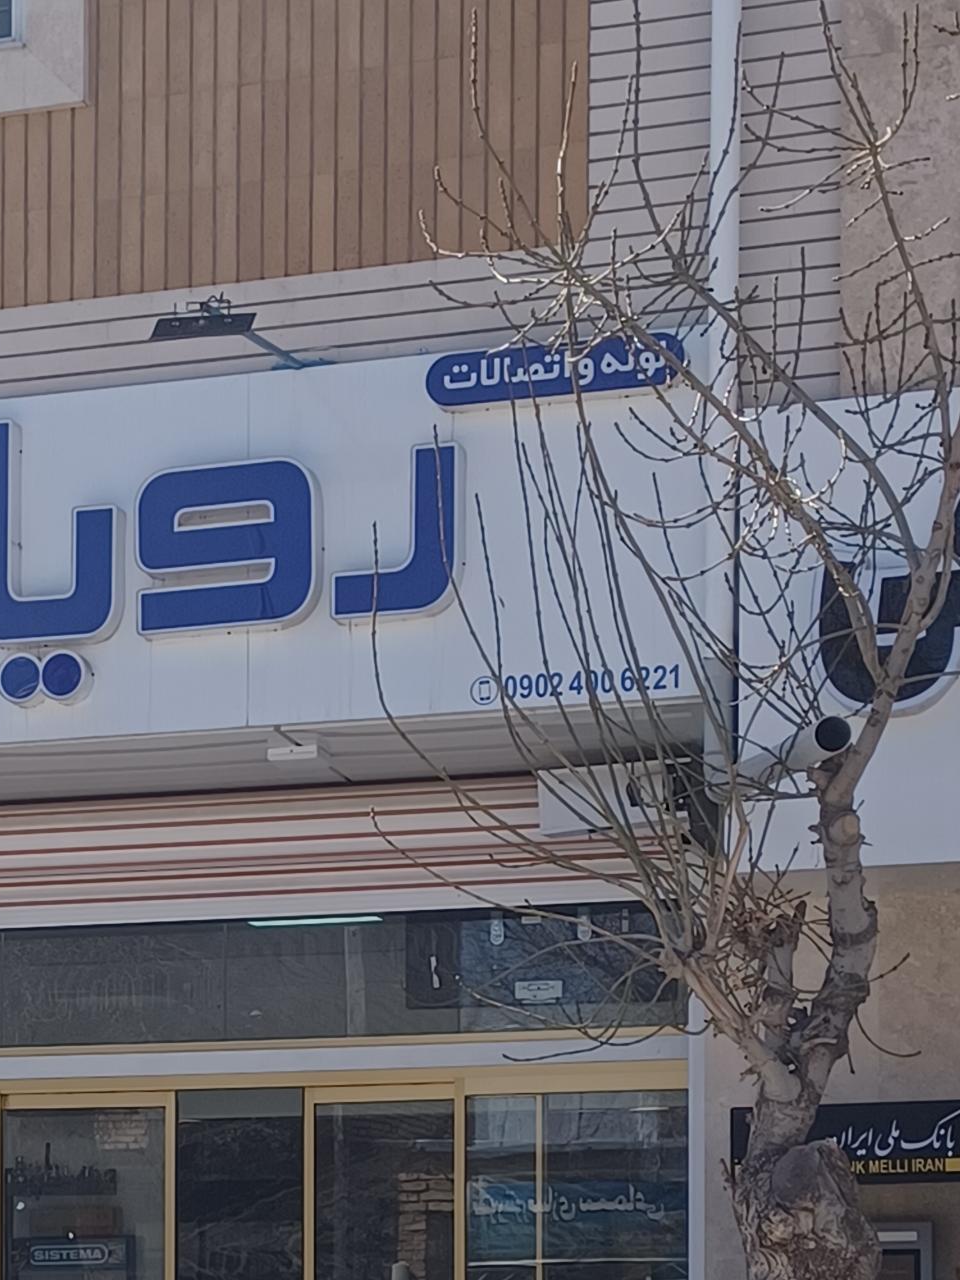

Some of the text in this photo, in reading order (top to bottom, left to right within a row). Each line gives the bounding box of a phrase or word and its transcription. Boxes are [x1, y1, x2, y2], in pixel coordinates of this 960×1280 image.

[443, 350, 573, 390] اتصالات
[504, 672, 563, 700] 0902
[620, 663, 680, 693] 6221
[874, 1119, 901, 1157] ملی
[900, 1108, 960, 1157] بانک
[869, 1158, 908, 1174] MELLI
[912, 1157, 944, 1173] IRAN
[34, 1249, 102, 1260] SISTEMA
